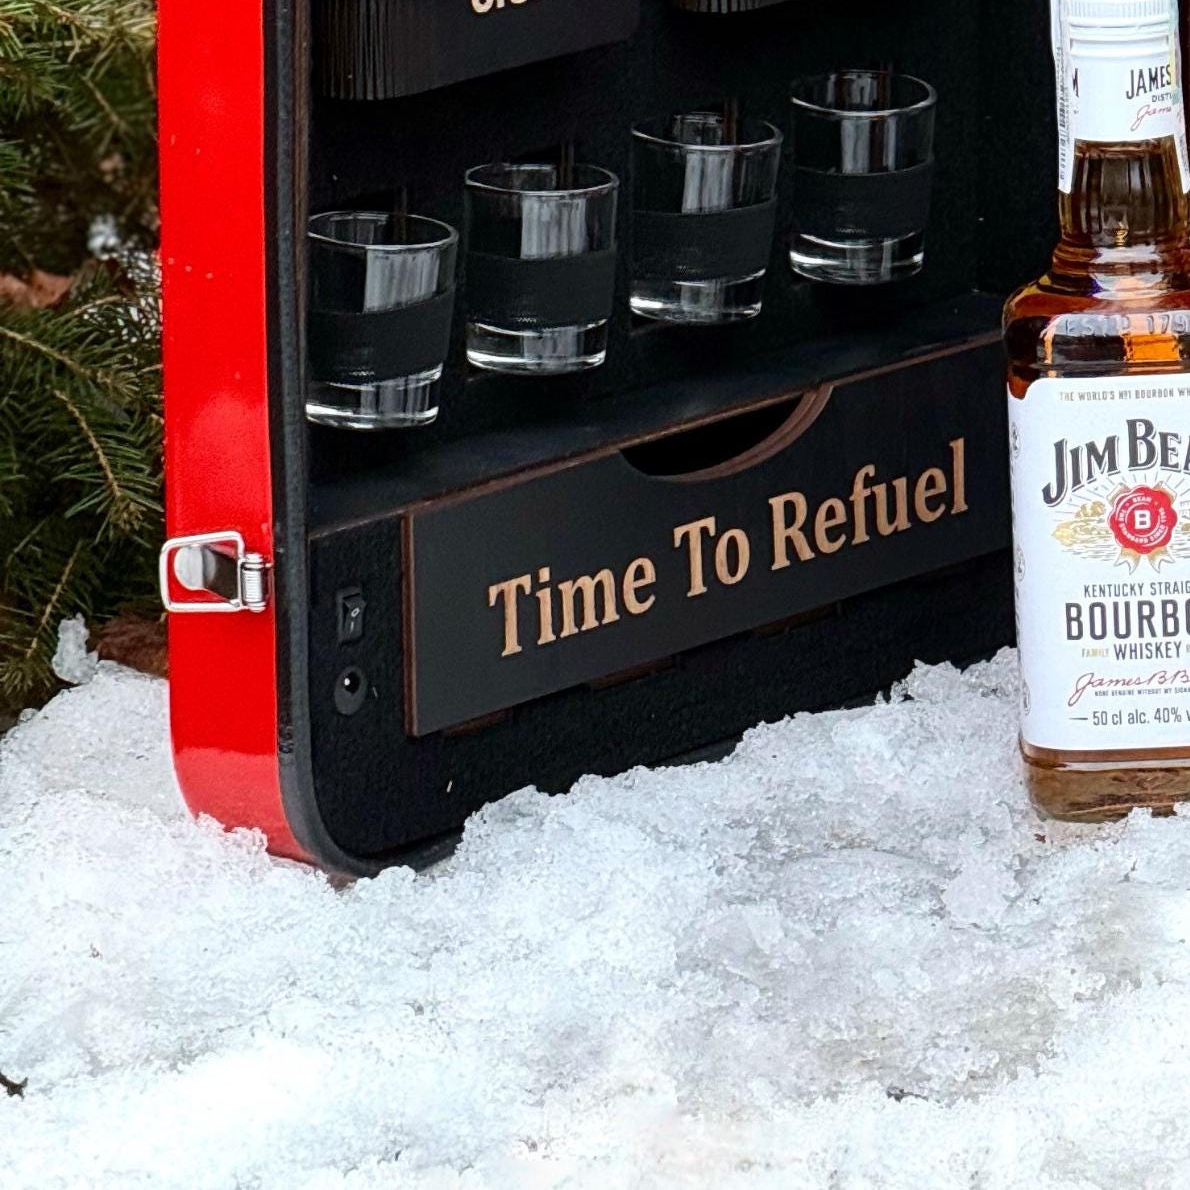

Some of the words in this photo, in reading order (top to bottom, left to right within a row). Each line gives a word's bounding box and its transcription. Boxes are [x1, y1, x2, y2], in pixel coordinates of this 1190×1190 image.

[1126, 64, 1171, 100] JAMES
[1060, 390, 1074, 402] THE
[1078, 387, 1115, 402] WORLD'S
[1135, 387, 1174, 400] BOURBON
[1042, 434, 1120, 508] JIM
[1134, 510, 1151, 529] B
[489, 556, 657, 657] Time
[673, 516, 751, 597] To
[768, 437, 969, 571] Refuel
[1084, 582, 1144, 598] KENTUCKY
[1082, 648, 1110, 658] FAMILY
[1114, 641, 1182, 661] WHISKEY
[1092, 710, 1109, 726] 50
[1111, 710, 1123, 726] cl
[1127, 709, 1150, 725] alc.
[1153, 706, 1182, 724] 40%
